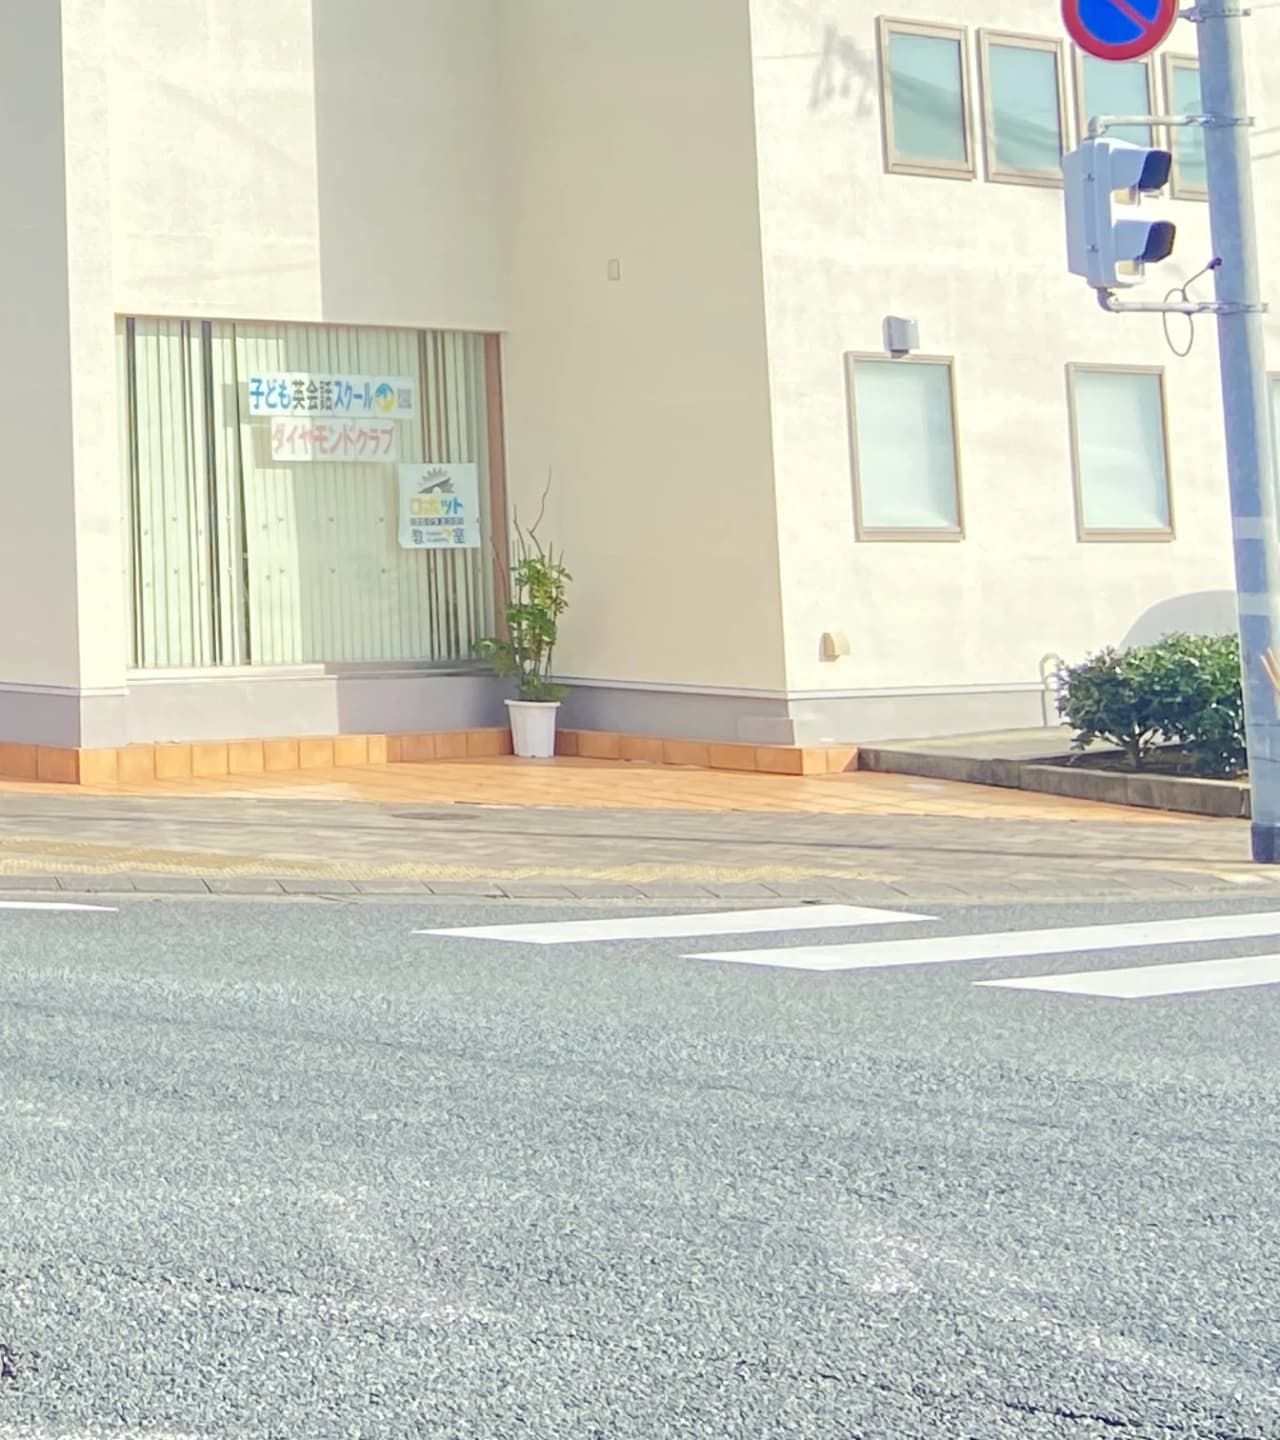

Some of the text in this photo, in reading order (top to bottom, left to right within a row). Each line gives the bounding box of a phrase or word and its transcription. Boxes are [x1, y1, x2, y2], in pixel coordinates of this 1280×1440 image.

[250, 377, 373, 410] 子ども英会話スクール
[272, 423, 395, 456] ダイヤモンドクラブ
